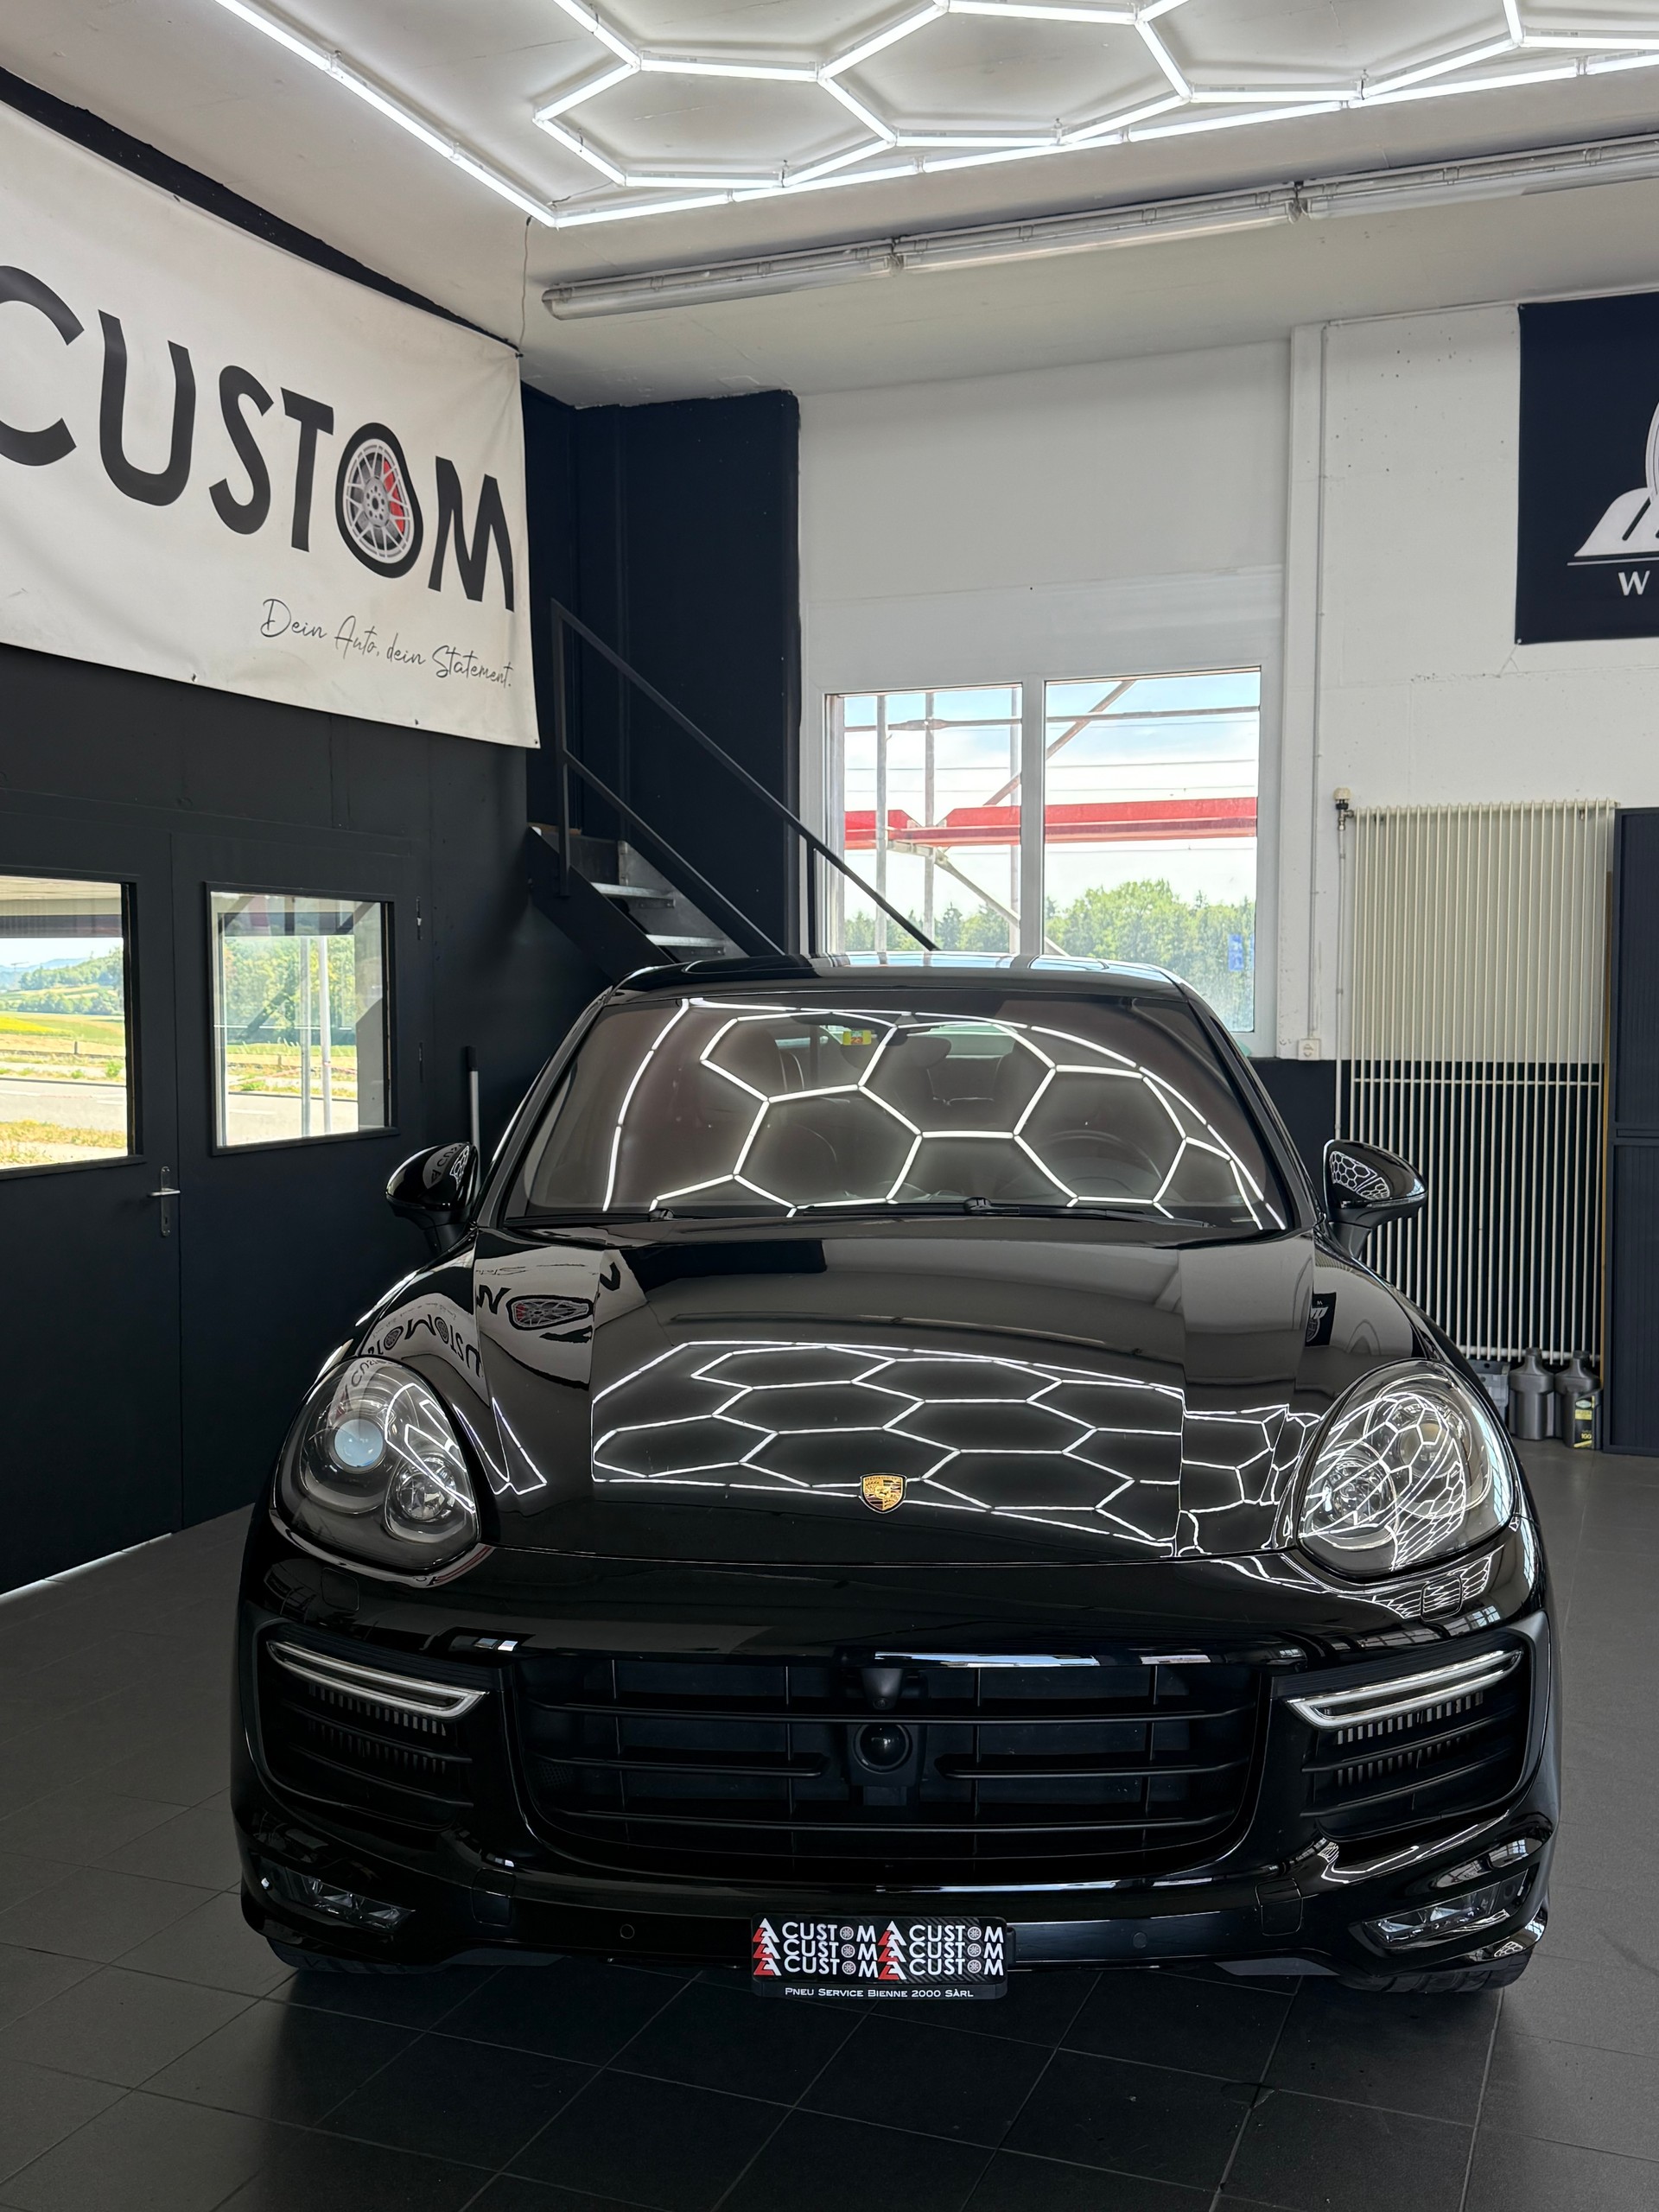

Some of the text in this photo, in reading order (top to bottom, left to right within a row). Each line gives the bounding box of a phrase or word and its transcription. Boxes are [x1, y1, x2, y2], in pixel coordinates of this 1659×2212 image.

[260, 598, 515, 689] Dein Auto, dein Statement.
[782, 1922, 1004, 1943] CUSTOM CUSTOM
[783, 1939, 1004, 1961] CUSTOM CUSTOM
[784, 1955, 1004, 1978] CUSTOM CUSTOM
